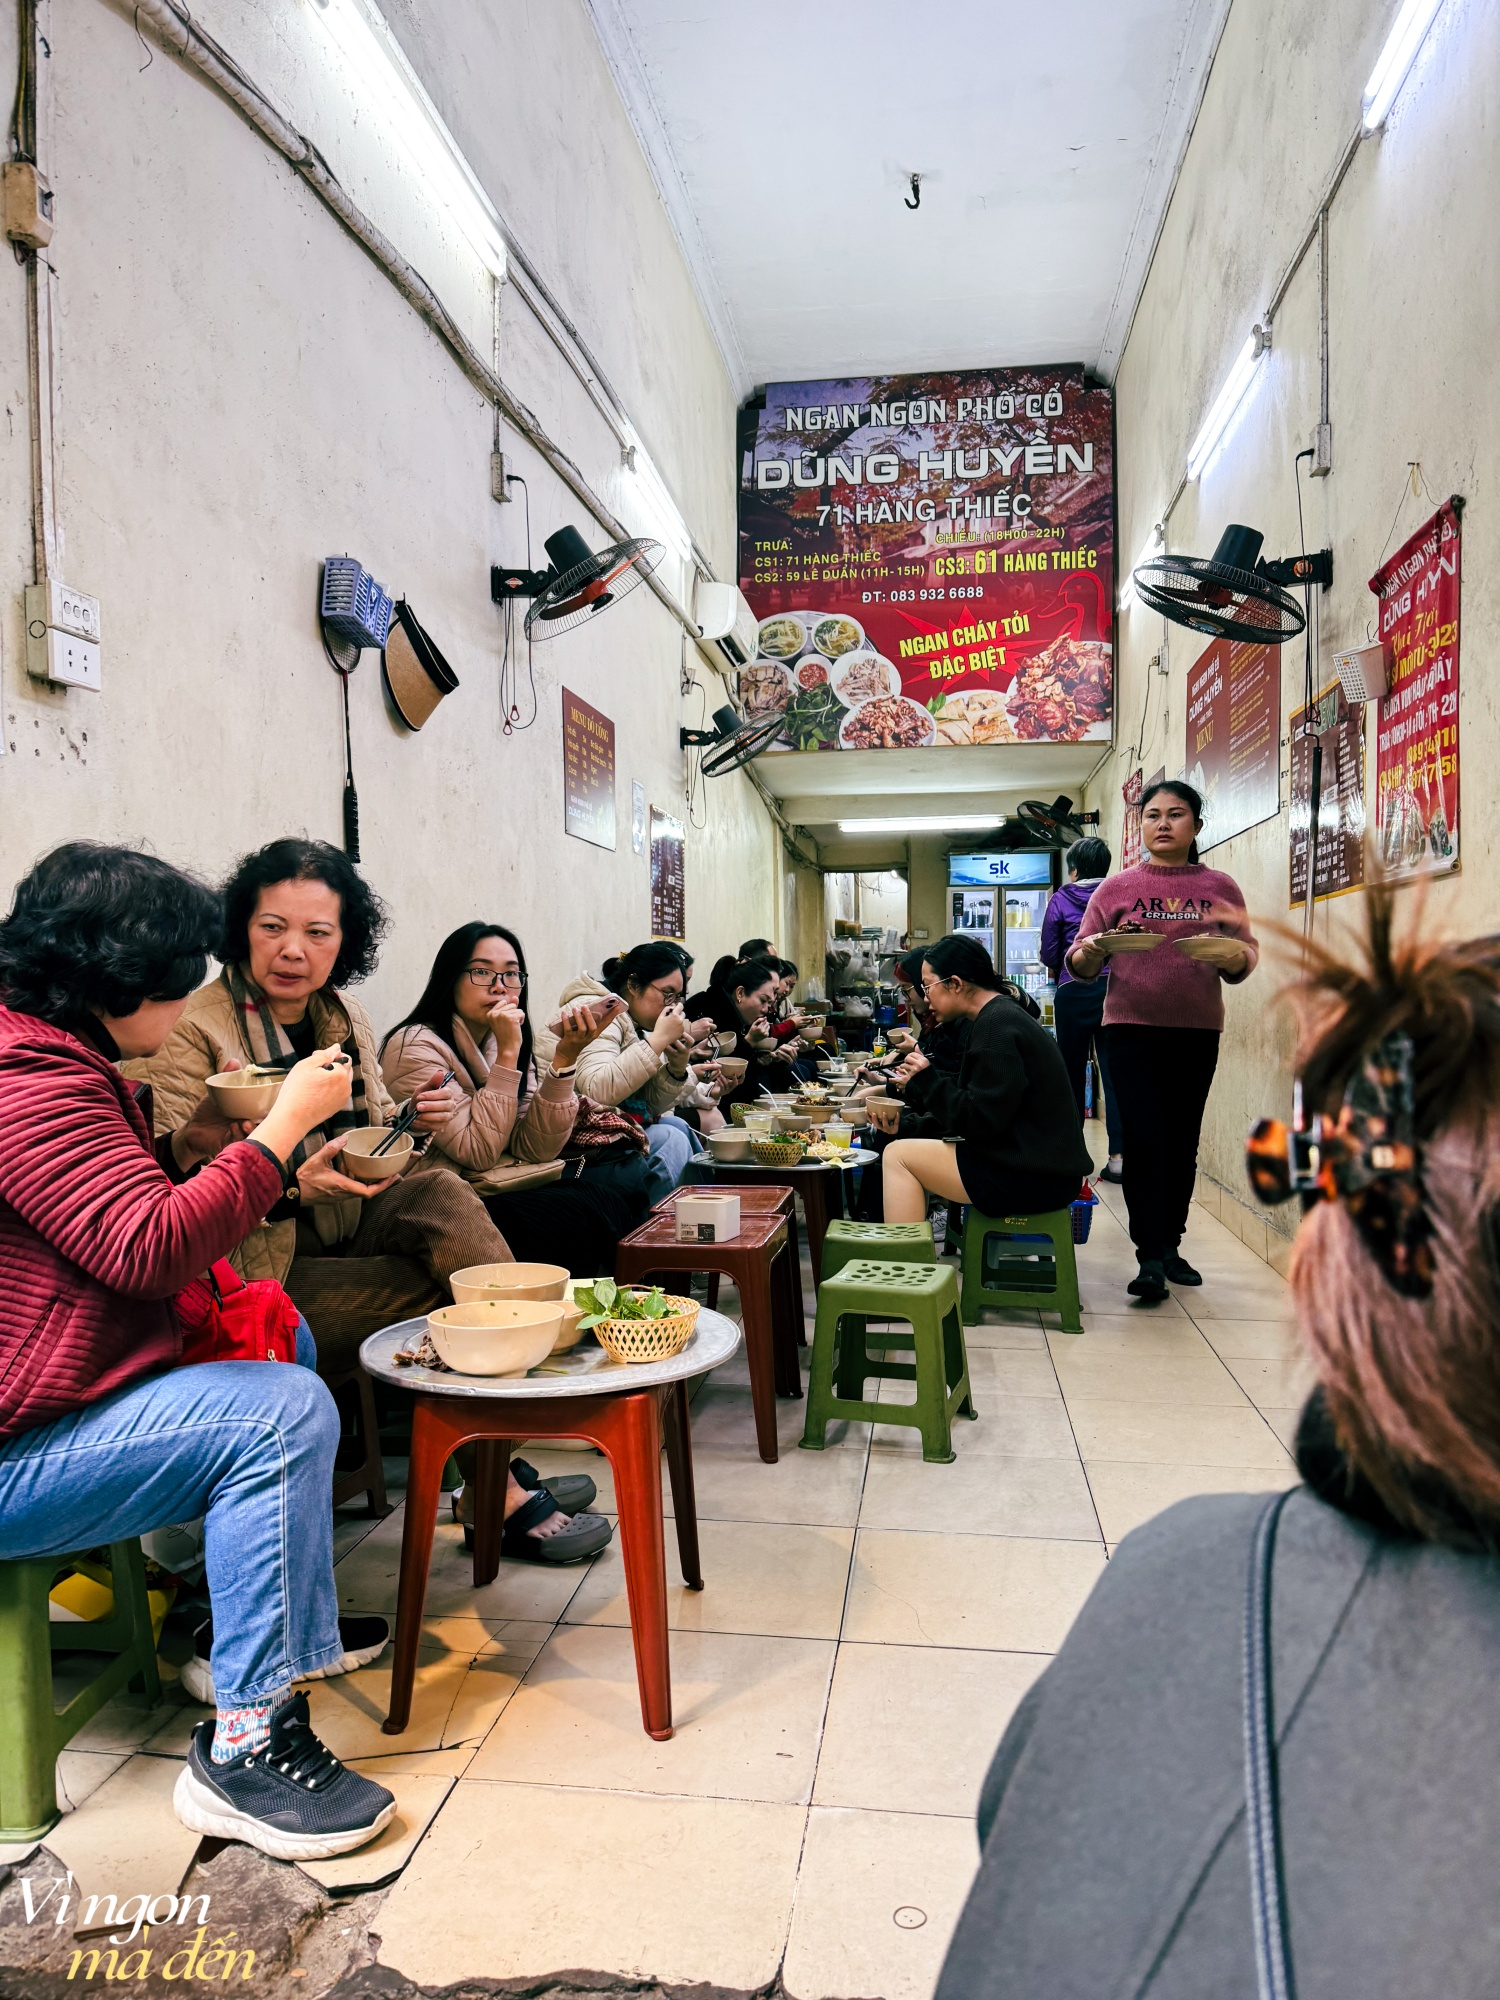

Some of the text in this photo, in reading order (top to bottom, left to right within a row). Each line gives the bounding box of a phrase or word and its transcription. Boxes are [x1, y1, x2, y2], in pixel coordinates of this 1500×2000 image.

[785, 382, 1062, 431] NGAN NGON PHỐ CỔ
[757, 428, 1094, 490] DŨNG HUYỀN
[816, 485, 1032, 527] 71 HÀNG THIẾC
[755, 541, 793, 552] TRƯA:
[935, 528, 980, 544] CHIỀU:
[754, 548, 881, 568] CS1: 71 HÀNG THIẾC
[935, 544, 1098, 576] CS3: 61 HÀNG THIẾC
[754, 573, 783, 583] CS2:
[786, 571, 800, 582] 59
[803, 568, 819, 581] LÊ
[822, 564, 858, 580] DUẨN
[861, 586, 984, 603] ĐT: 083 932 6688
[899, 610, 1031, 658] NGAN CHÁY TỎI
[929, 645, 1007, 680] ĐẶC BIỆT
[1196, 719, 1214, 754] MENU
[989, 860, 1010, 874] sk
[1145, 911, 1200, 920] CRIMSON
